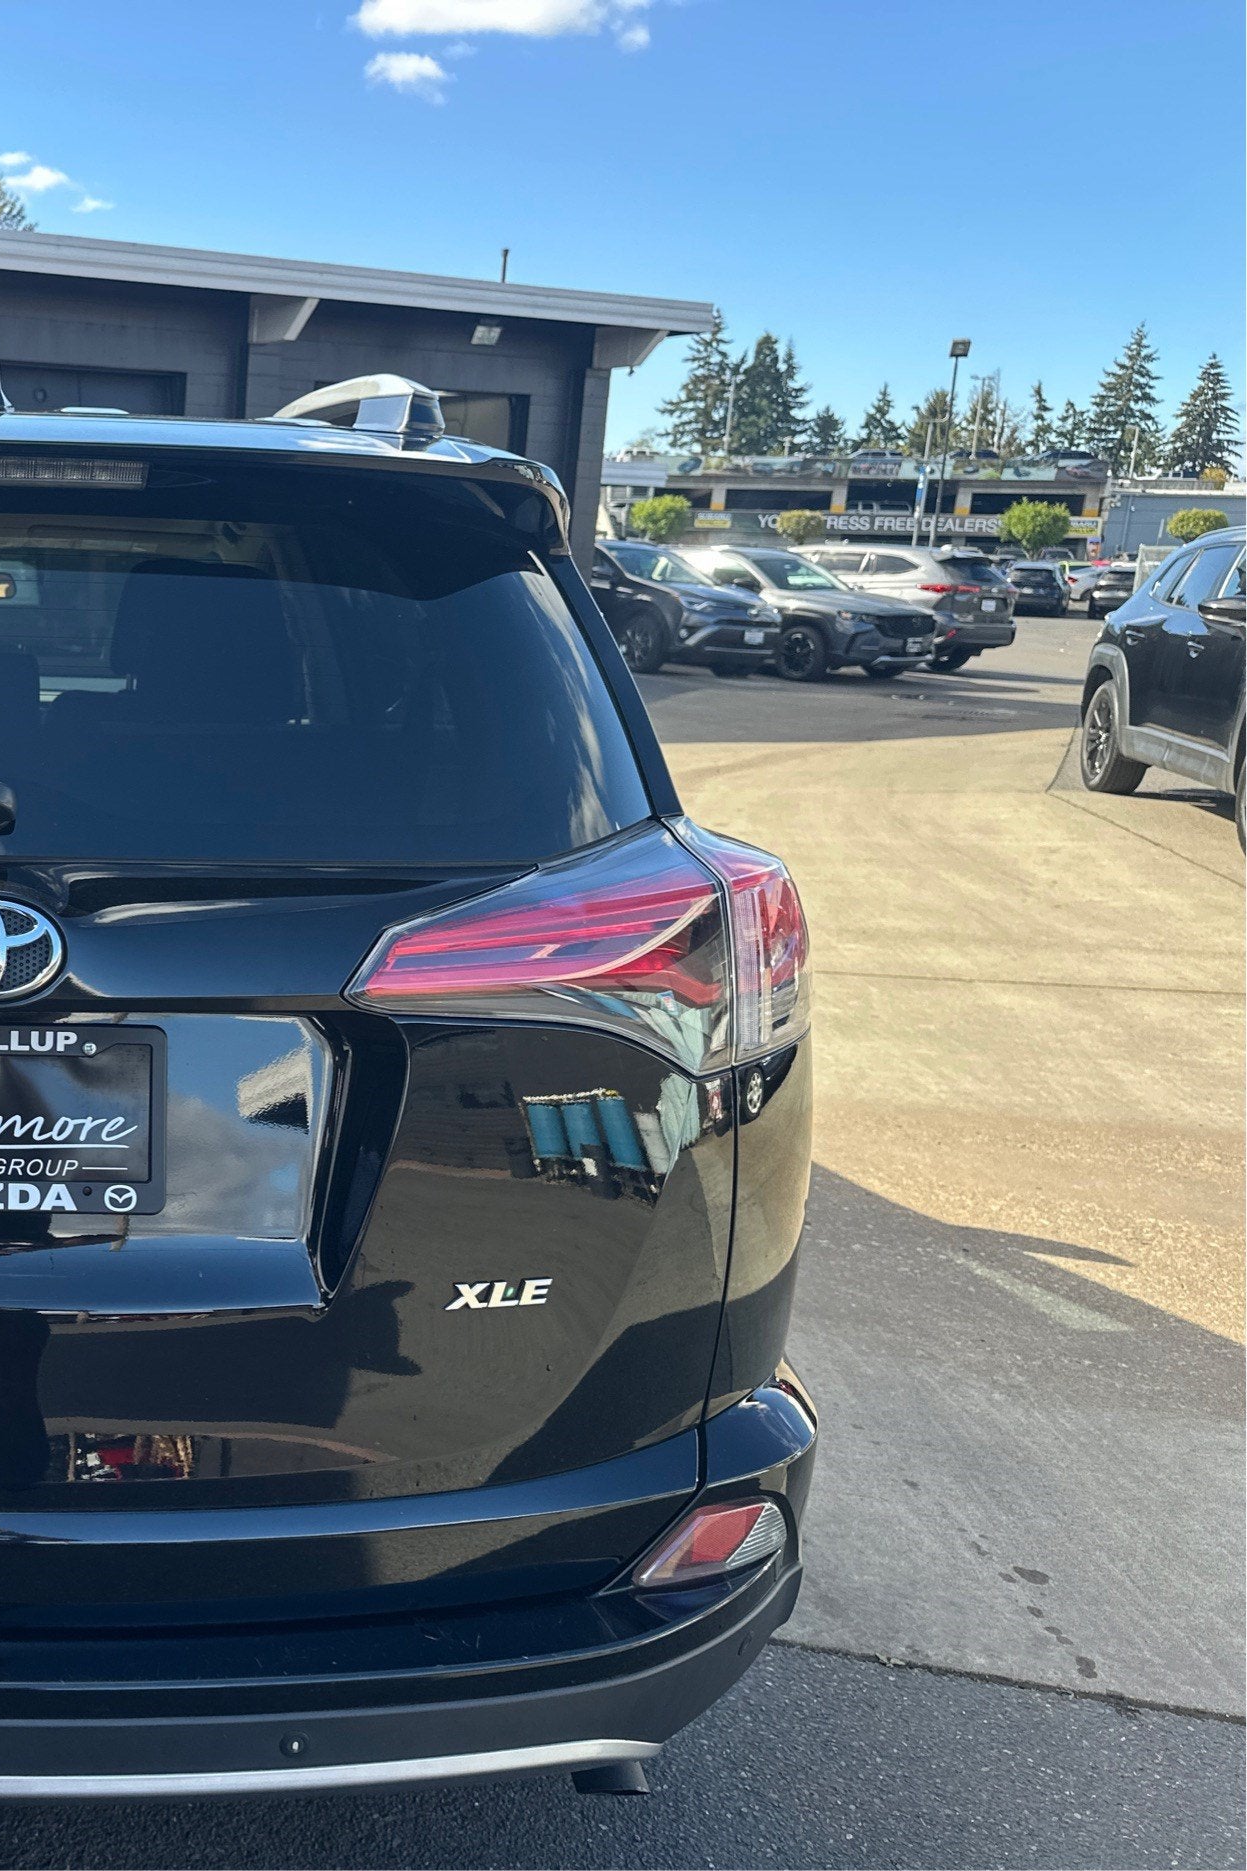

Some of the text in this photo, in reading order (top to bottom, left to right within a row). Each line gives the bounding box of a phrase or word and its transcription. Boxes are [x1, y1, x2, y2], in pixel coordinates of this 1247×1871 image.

[873, 516, 917, 531] FREE
[921, 517, 1002, 532] DEALERS
[443, 1278, 554, 1311] XLE
